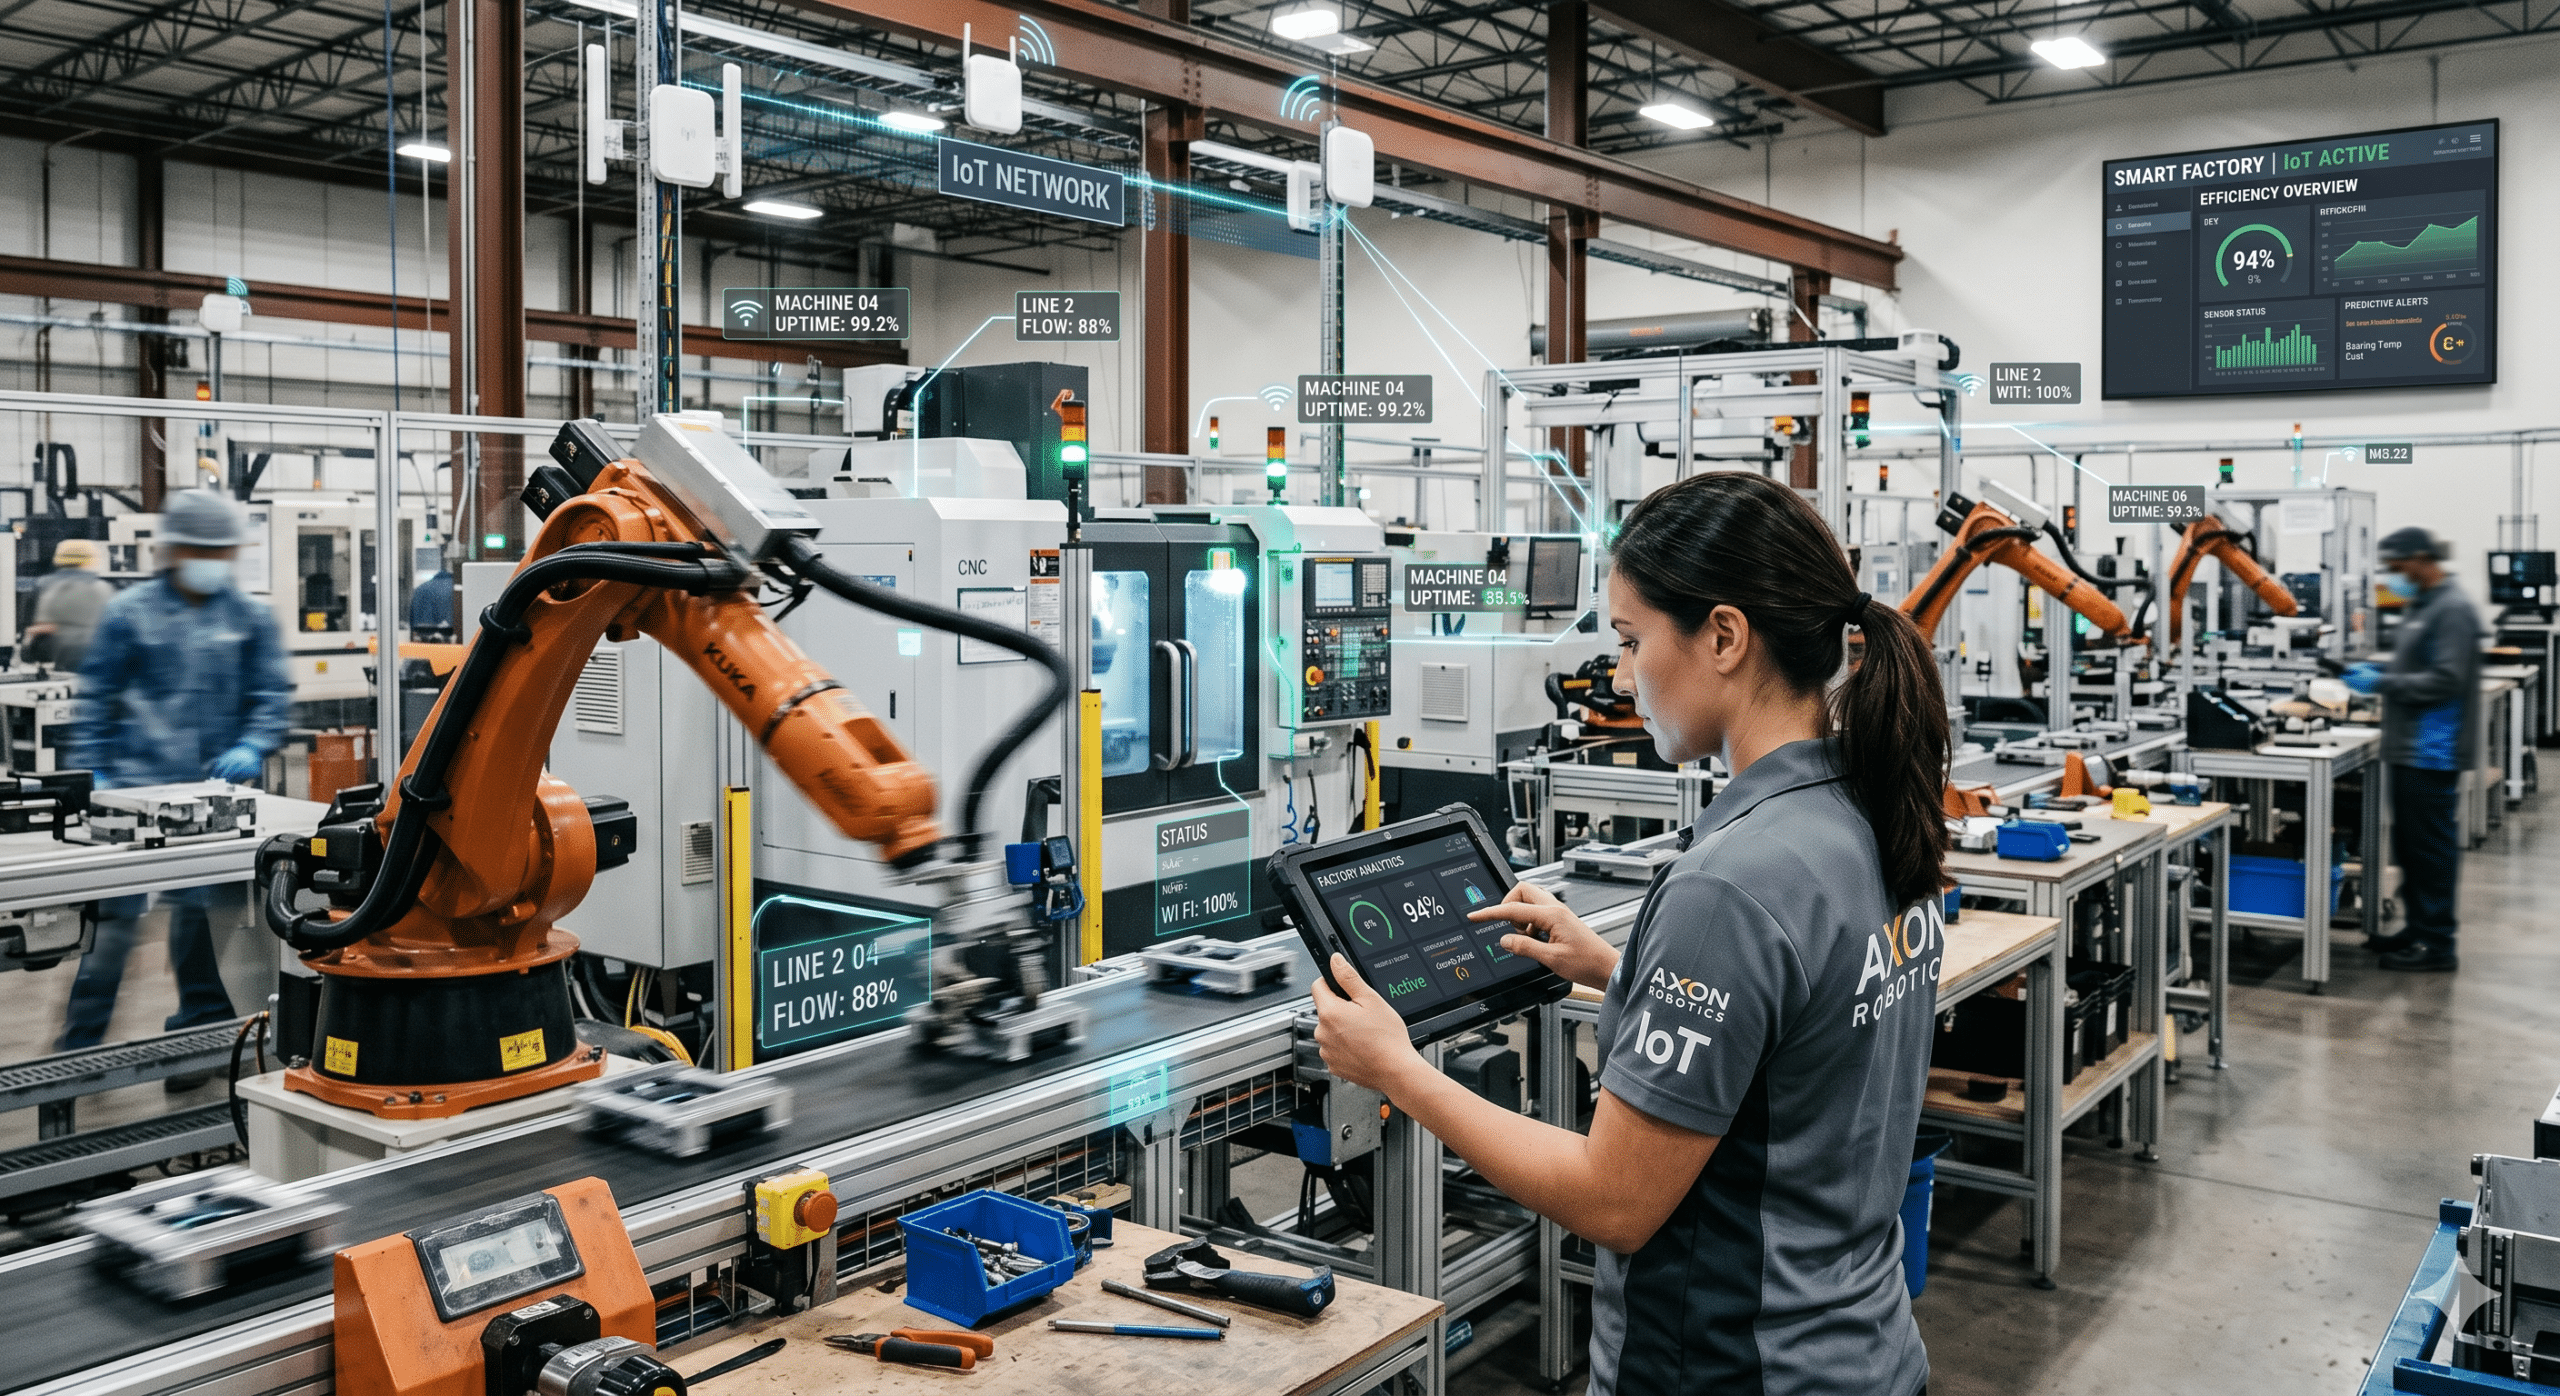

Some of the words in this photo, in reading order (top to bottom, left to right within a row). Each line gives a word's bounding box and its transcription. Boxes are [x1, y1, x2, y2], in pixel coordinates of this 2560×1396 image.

[2114, 164, 2177, 187] SMART
[2182, 155, 2265, 180] FACTORY
[2283, 150, 2313, 171] IoT
[2318, 142, 2390, 167] ACTIVE
[2200, 185, 2280, 206] EFFICIENCY
[2283, 178, 2358, 198] OVERVIEW
[2233, 249, 2275, 271] 94%
[2247, 274, 2262, 284] 9%
[2204, 309, 2235, 319] SENSOR
[2236, 307, 2267, 317] STATUS
[2345, 299, 2394, 310] PREDICTIVE
[2395, 297, 2429, 307] ALERTS
[2378, 340, 2403, 351] Temp
[958, 559, 988, 576] CNC
[703, 641, 757, 702] KUKA
[1316, 867, 1359, 888] FACTORY
[1359, 855, 1405, 877] ANALYTICS
[1402, 895, 1445, 923] 94%
[1855, 886, 1945, 996] AXON
[1387, 976, 1427, 999] Active
[1650, 966, 1731, 1011] AXON
[1852, 956, 1941, 1028] ROBOTIC
[1648, 985, 1726, 1023] ROBOTICS
[1634, 1010, 1712, 1075] IoT
